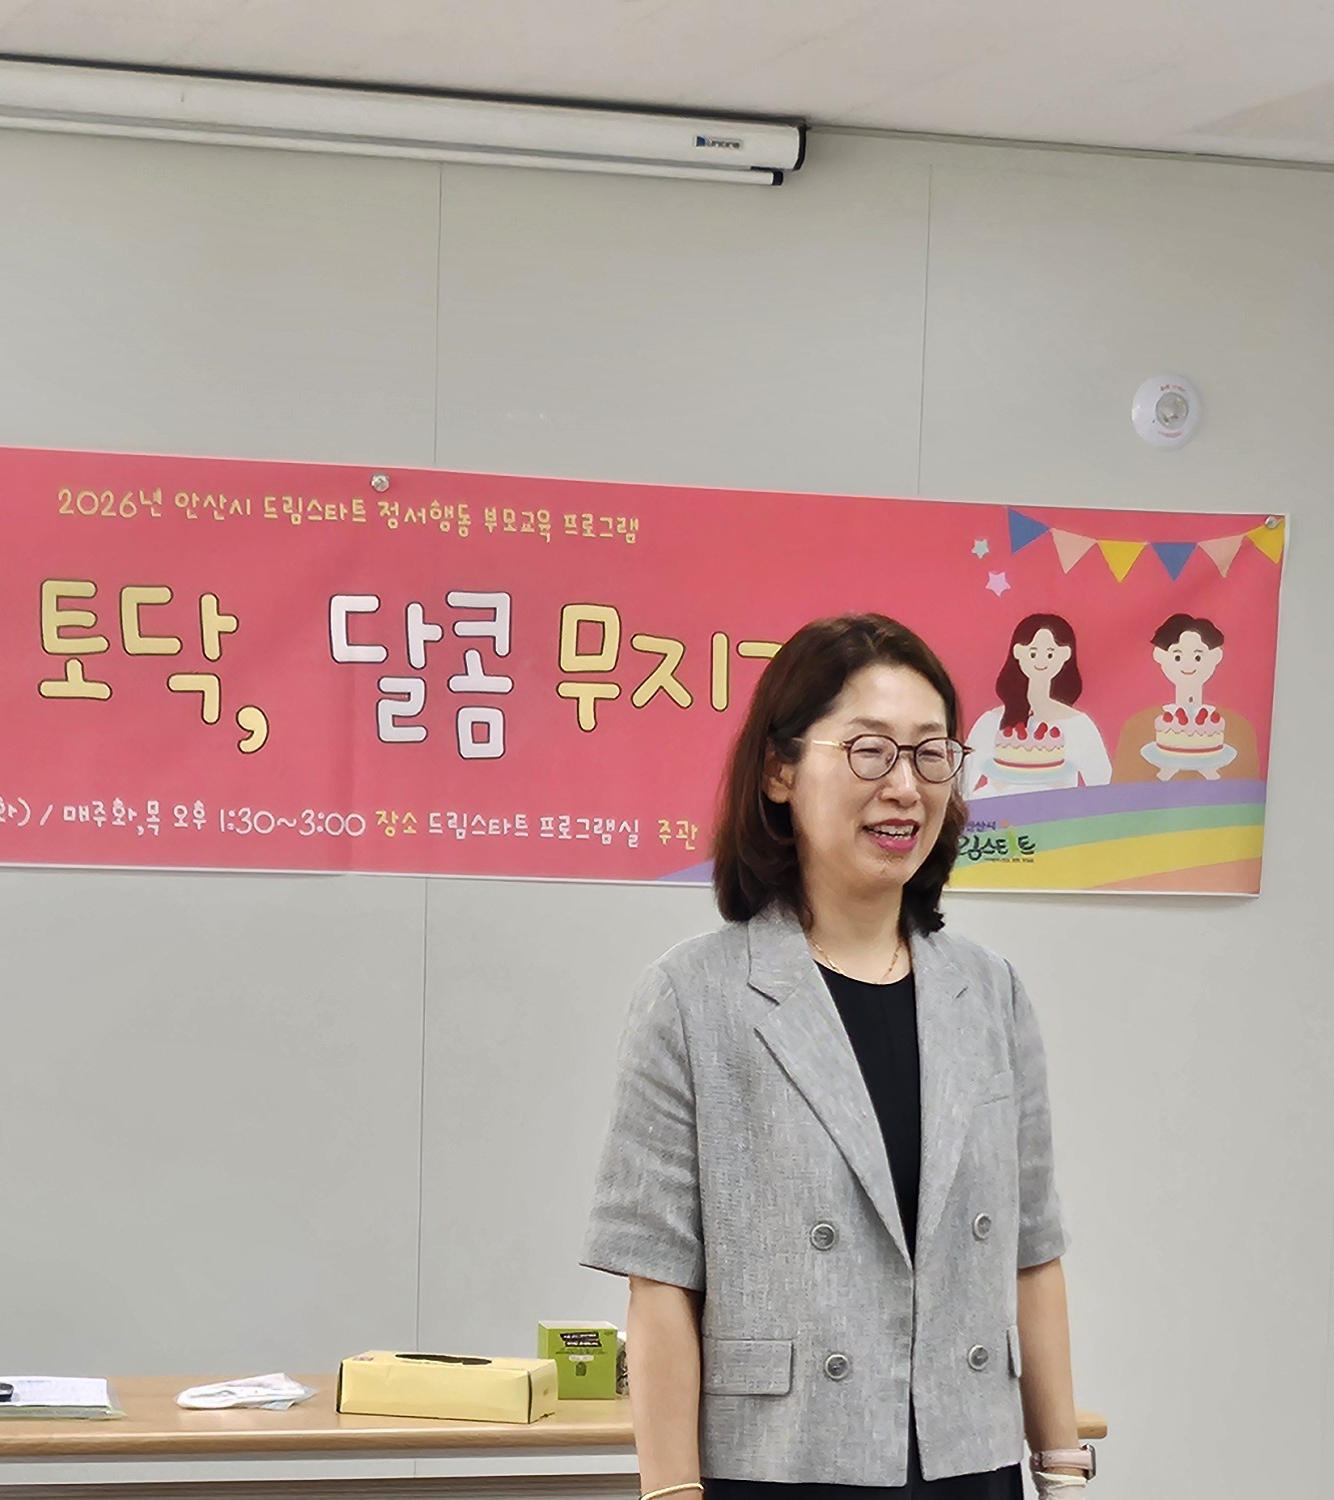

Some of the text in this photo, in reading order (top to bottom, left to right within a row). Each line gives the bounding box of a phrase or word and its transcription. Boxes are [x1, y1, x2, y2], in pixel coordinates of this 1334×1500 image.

[58, 487, 640, 544] 2026년 안산시 드림스타트 정서행동 부모교육 프로그램
[38, 578, 269, 754] 토닥,
[329, 591, 514, 759] 달콤
[557, 602, 785, 732] 무지
[173, 800, 207, 830] 오후
[219, 806, 366, 837] 1:30~3:00
[374, 810, 417, 837] 장소
[428, 812, 529, 840] 드림스타트
[539, 815, 640, 848] 프로그램실
[657, 819, 699, 851] 주관
